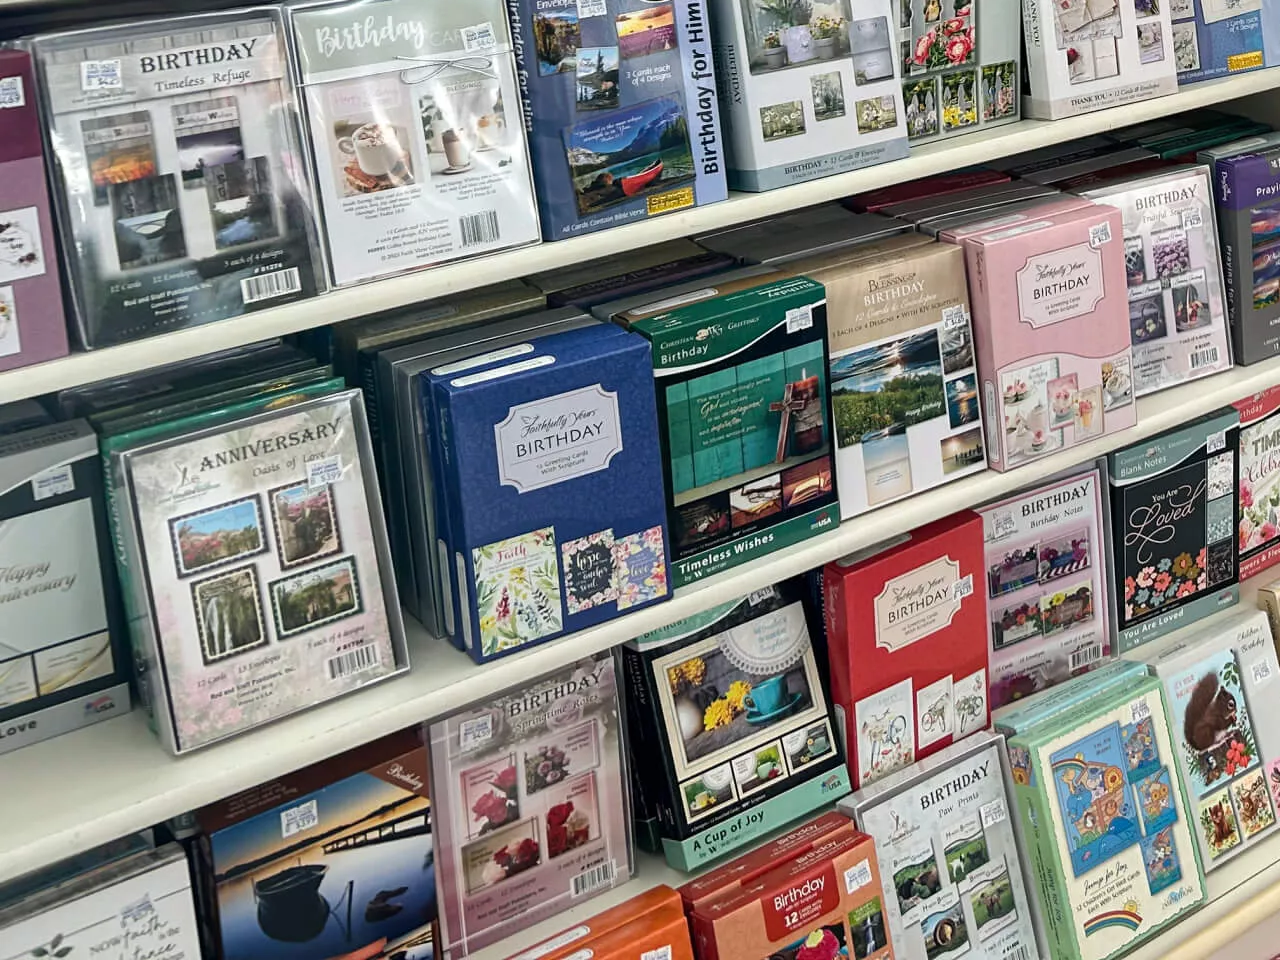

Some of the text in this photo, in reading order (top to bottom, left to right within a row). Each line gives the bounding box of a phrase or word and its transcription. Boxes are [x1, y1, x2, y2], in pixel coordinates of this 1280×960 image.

[315, 15, 427, 57] Birthday
[139, 38, 258, 74] BIRTHDAY
[154, 67, 252, 92] Timeless Refuge
[686, 2, 720, 176] Birthday for Him
[783, 159, 823, 176] BIRTHDAY
[1134, 183, 1199, 212] BIRTHDAY
[864, 280, 925, 306] BIRTHDAY
[1032, 273, 1090, 300] BIRTHDAY
[660, 343, 710, 365] Birthday
[199, 417, 342, 472] ANNIVERSARY
[516, 420, 604, 458] BIRTHDAY
[252, 463, 281, 478] Oasis
[302, 450, 326, 463] Love
[1120, 454, 1167, 478] Blank Notes
[1021, 480, 1090, 517] BIRTHDAY
[1152, 488, 1179, 503] You Are
[1030, 504, 1084, 530] Birthday Notes
[678, 532, 775, 574] Timeless Wishes
[888, 584, 950, 624] BIRTHDAY
[1123, 608, 1184, 641] You Are Loved
[508, 672, 601, 718] BIRTHDAY
[514, 693, 599, 732] Springtime Roses
[919, 760, 992, 811] BIRTHDAY
[692, 809, 765, 851] A Cup of Joy
[774, 873, 825, 911] Birthday
[783, 911, 799, 927] 12
